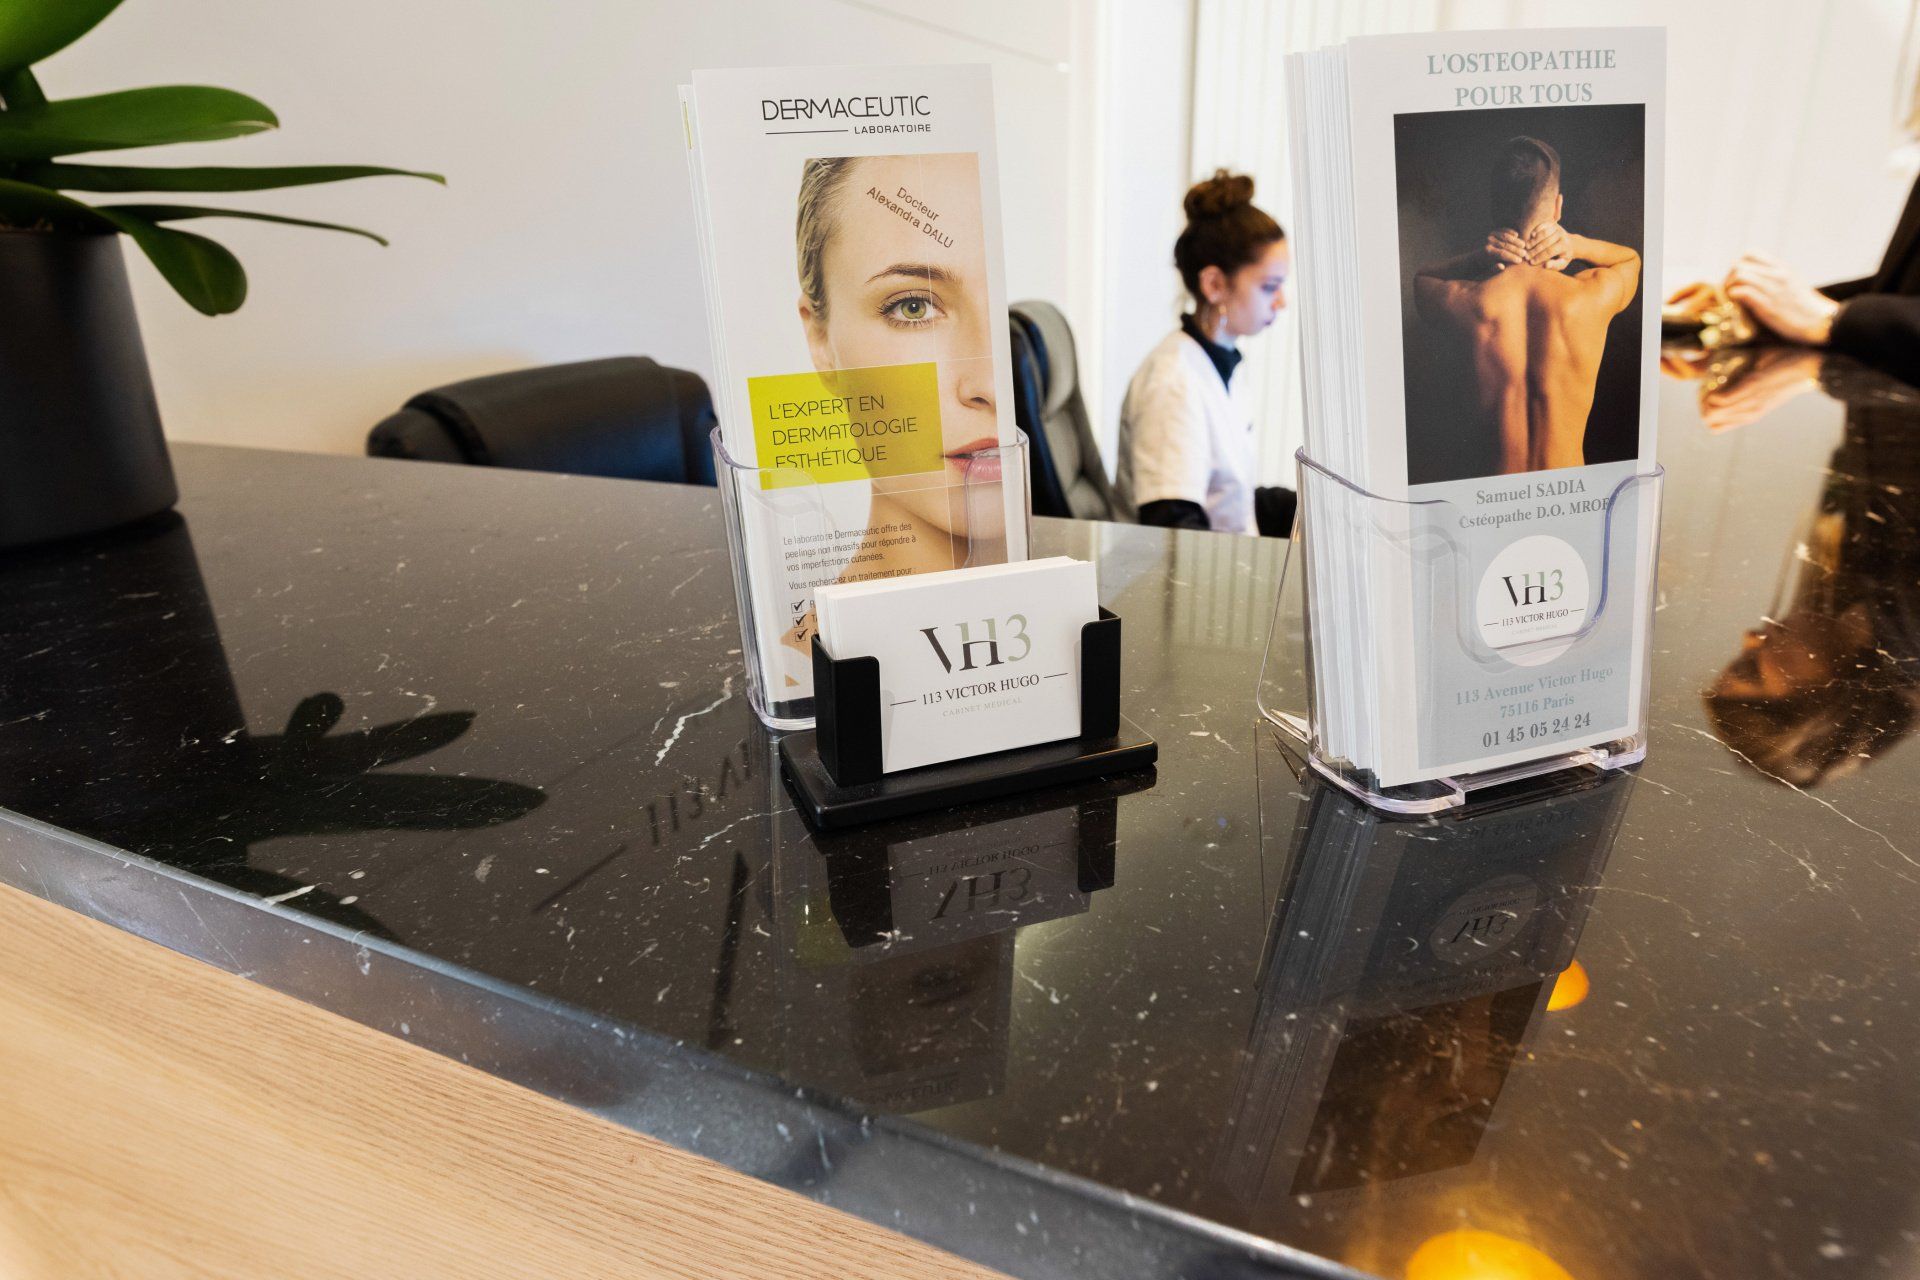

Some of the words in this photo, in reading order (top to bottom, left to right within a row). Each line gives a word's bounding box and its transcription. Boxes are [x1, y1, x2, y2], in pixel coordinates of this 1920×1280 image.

[1426, 49, 1616, 75] L'OSTEOPATHIE
[761, 95, 931, 121] DERMACEUTIC
[1454, 85, 1524, 107] POUR
[1530, 83, 1593, 104] TOUS
[854, 124, 932, 135] LABORATOIRE
[896, 186, 939, 222] Docteur
[866, 186, 920, 229] Alexandra
[922, 222, 954, 249] DALU
[769, 397, 853, 421] L'EXPERT
[860, 395, 885, 412] EN
[772, 416, 919, 446] DERMATOLOGIE
[775, 445, 888, 469] ESTHÉTIQUE
[1476, 485, 1531, 505] Samuel
[1536, 478, 1586, 498] SADIA
[1536, 504, 1565, 520] D.O.
[783, 537, 793, 546] Le
[794, 532, 833, 544] laboratore
[834, 527, 880, 539] Dermaceutic
[880, 523, 898, 534] offre
[899, 522, 912, 532] des
[785, 547, 817, 560] peelings
[818, 546, 831, 555] non
[833, 541, 860, 552] invasifs
[861, 541, 878, 550] pour
[879, 535, 910, 548] répondre
[911, 535, 917, 543] à
[786, 564, 800, 572] vos
[801, 557, 850, 571] imperfections
[789, 581, 807, 590] Vous
[808, 576, 846, 588] rechercez
[847, 575, 857, 583] un
[859, 569, 895, 581] traitement
[896, 567, 912, 578] pour
[1501, 618, 1514, 627] 113
[1515, 612, 1545, 624] VICTOR
[1546, 608, 1569, 619] HUGO
[922, 691, 943, 705] 113
[945, 681, 997, 700] VICTOR
[1000, 674, 1040, 692] HUGO
[1456, 689, 1480, 705] 113
[1484, 683, 1534, 700] Avenue
[1538, 674, 1576, 690] Victor
[1581, 666, 1614, 683] Hugo
[942, 704, 982, 717] CABINET
[1500, 701, 1539, 719] 75116
[1543, 692, 1575, 710] Paris
[1483, 731, 1500, 748] 01
[1506, 726, 1525, 743] 45
[1530, 720, 1548, 738] 05
[1552, 716, 1570, 734] 24
[1574, 711, 1592, 729] 24
